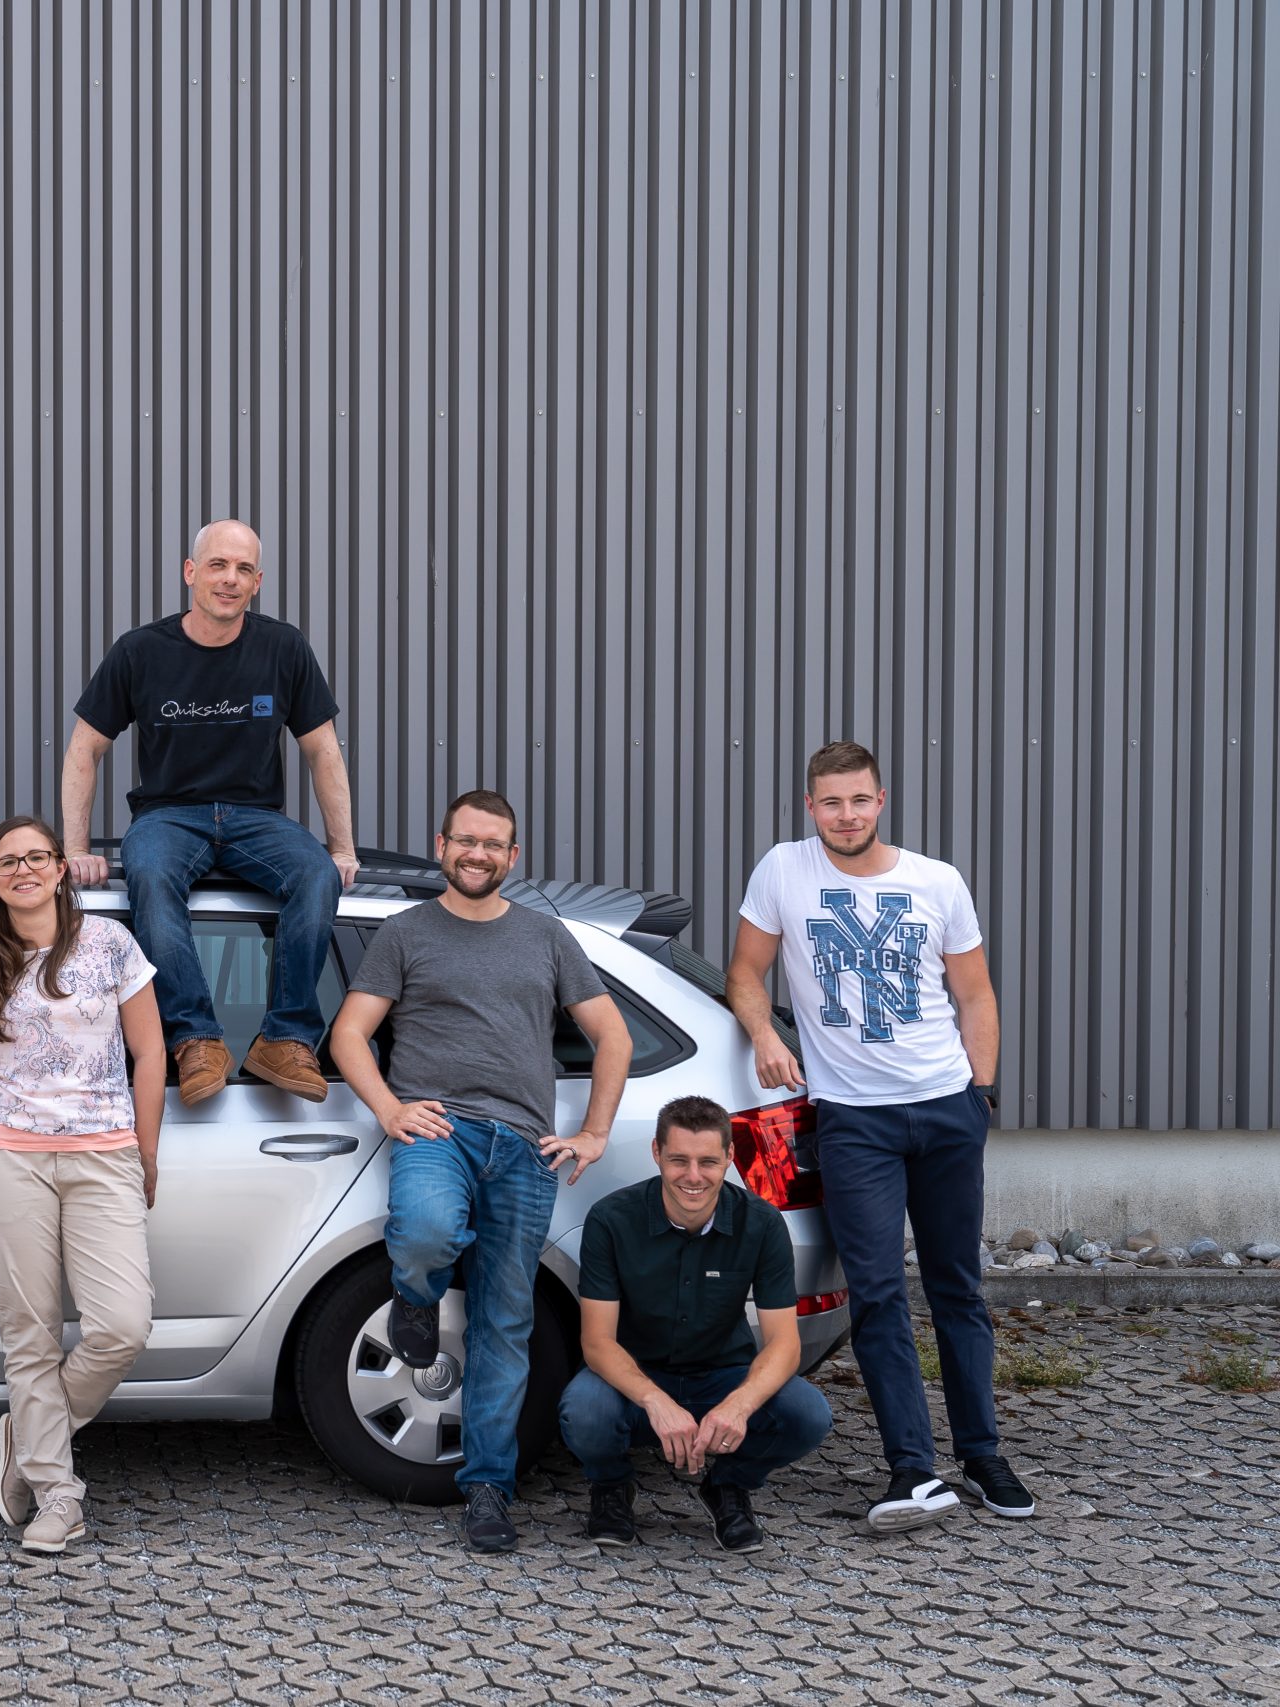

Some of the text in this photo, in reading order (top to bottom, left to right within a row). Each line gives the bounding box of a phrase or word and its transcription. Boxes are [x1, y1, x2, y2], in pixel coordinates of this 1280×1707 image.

[161, 700, 250, 719] Quiksilver
[813, 948, 924, 978] HILFIGER
[876, 981, 902, 1011] DENIM
